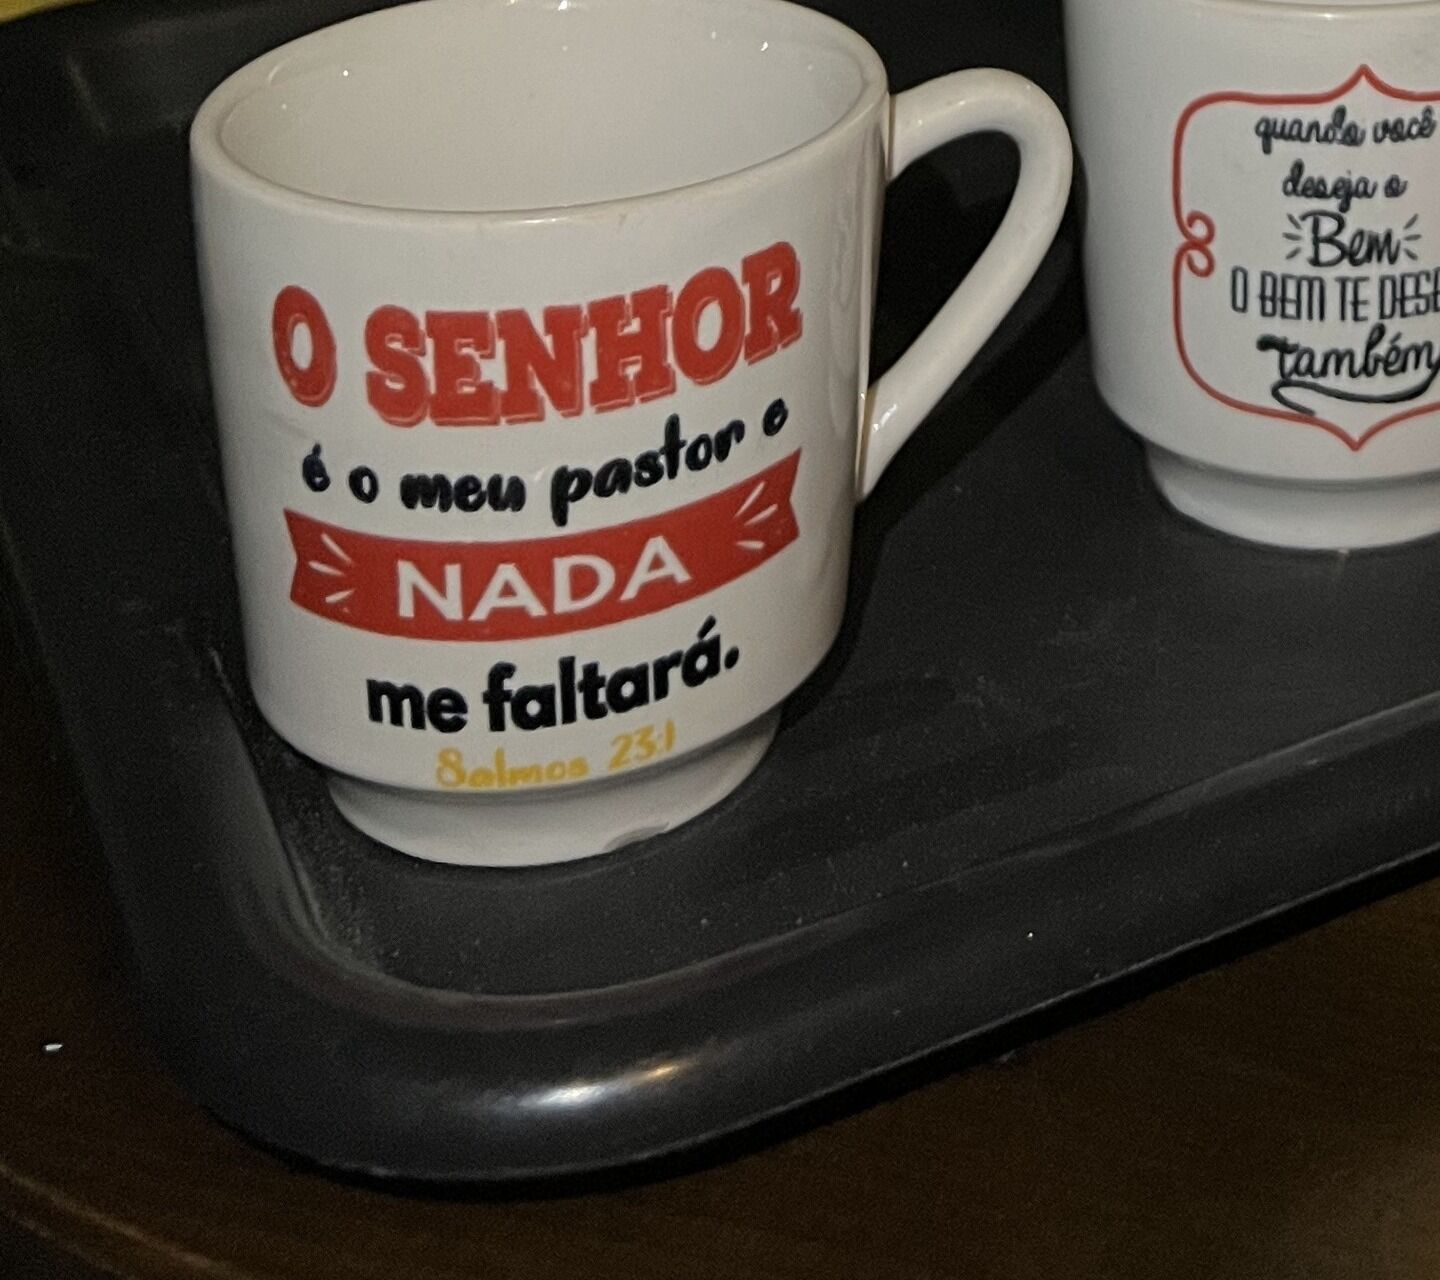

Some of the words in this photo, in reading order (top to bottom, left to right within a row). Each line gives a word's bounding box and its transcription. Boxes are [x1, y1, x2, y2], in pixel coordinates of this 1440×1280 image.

[1256, 105, 1365, 154] quando
[1374, 105, 1436, 143] você
[1283, 159, 1376, 212] deseja
[1384, 175, 1408, 198] o
[1300, 210, 1400, 266] Bem
[1231, 267, 1248, 313] O
[1259, 271, 1325, 321] BEM
[1335, 277, 1369, 321] TE
[273, 285, 337, 407] O
[364, 241, 802, 428] SENHOR
[303, 444, 330, 492] é
[348, 465, 378, 503] o
[400, 472, 525, 512] meu
[550, 414, 745, 525] pastor
[396, 535, 692, 621] NADA
[366, 678, 467, 733] me
[483, 616, 740, 732] faltará.
